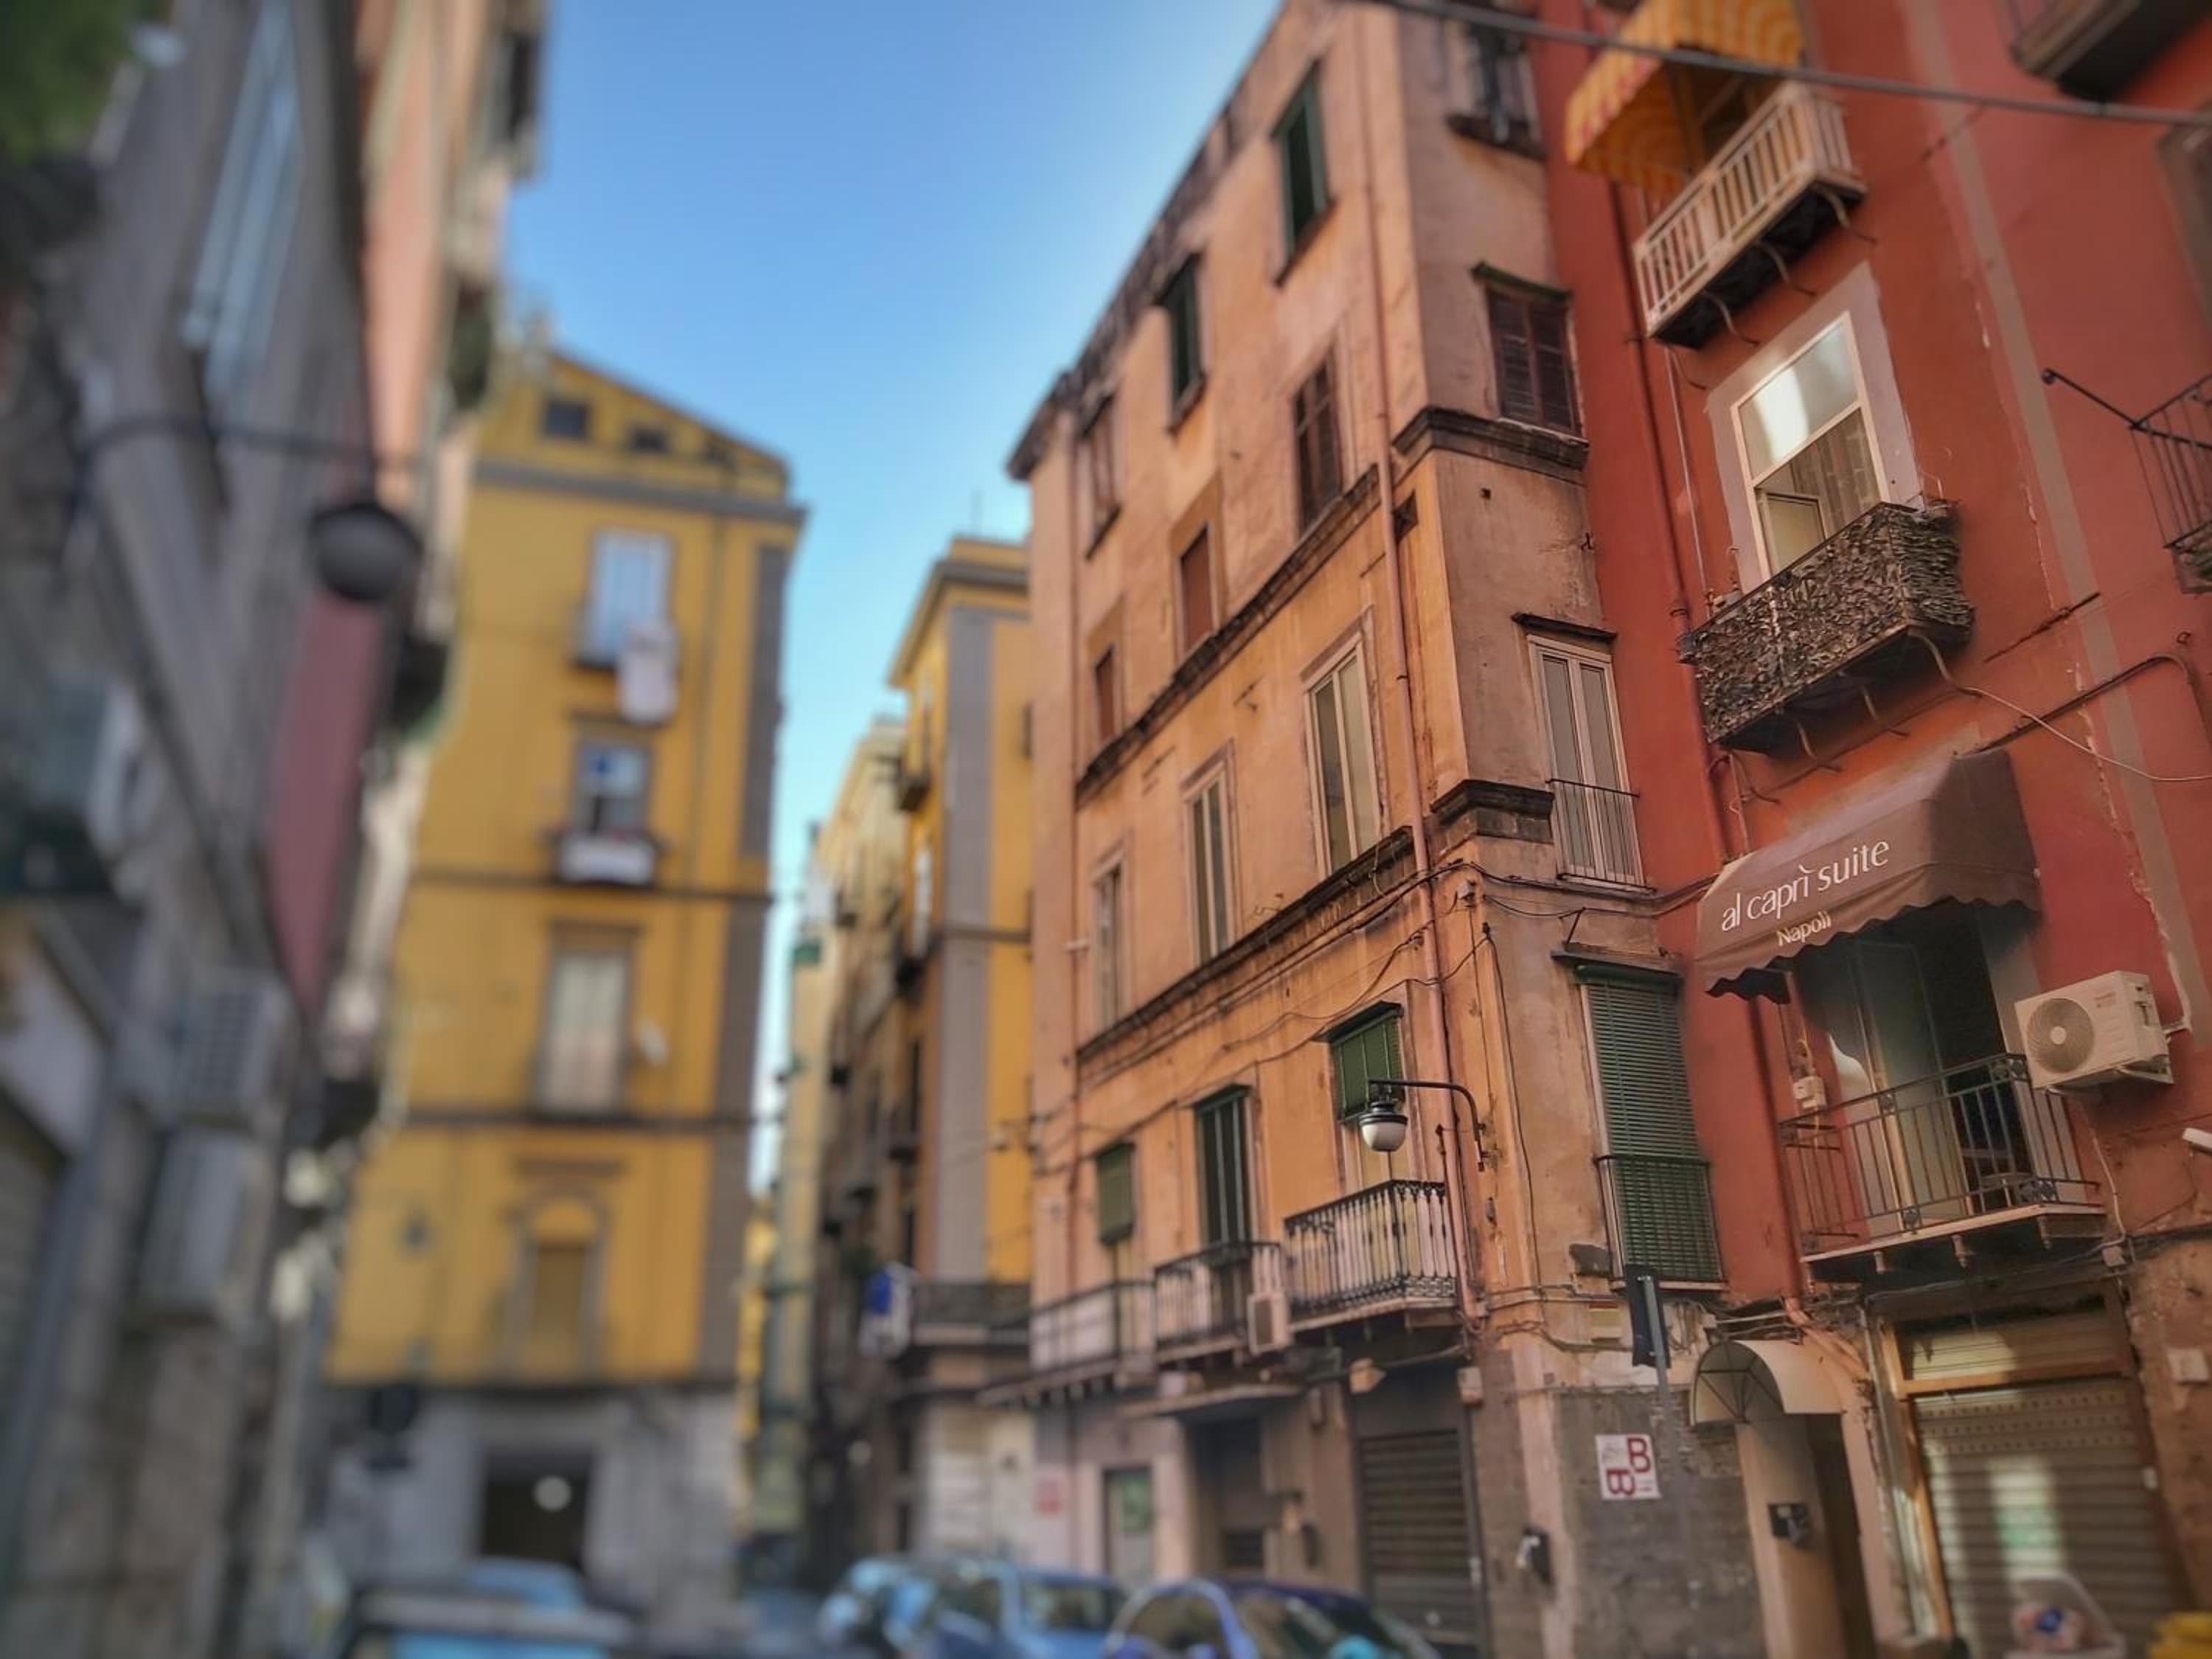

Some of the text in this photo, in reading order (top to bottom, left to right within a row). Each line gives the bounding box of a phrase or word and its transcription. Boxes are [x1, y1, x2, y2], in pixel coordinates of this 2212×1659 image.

[1722, 893, 1741, 931] al
[1818, 841, 1890, 891] suite
[1776, 910, 1832, 947] Napoli
